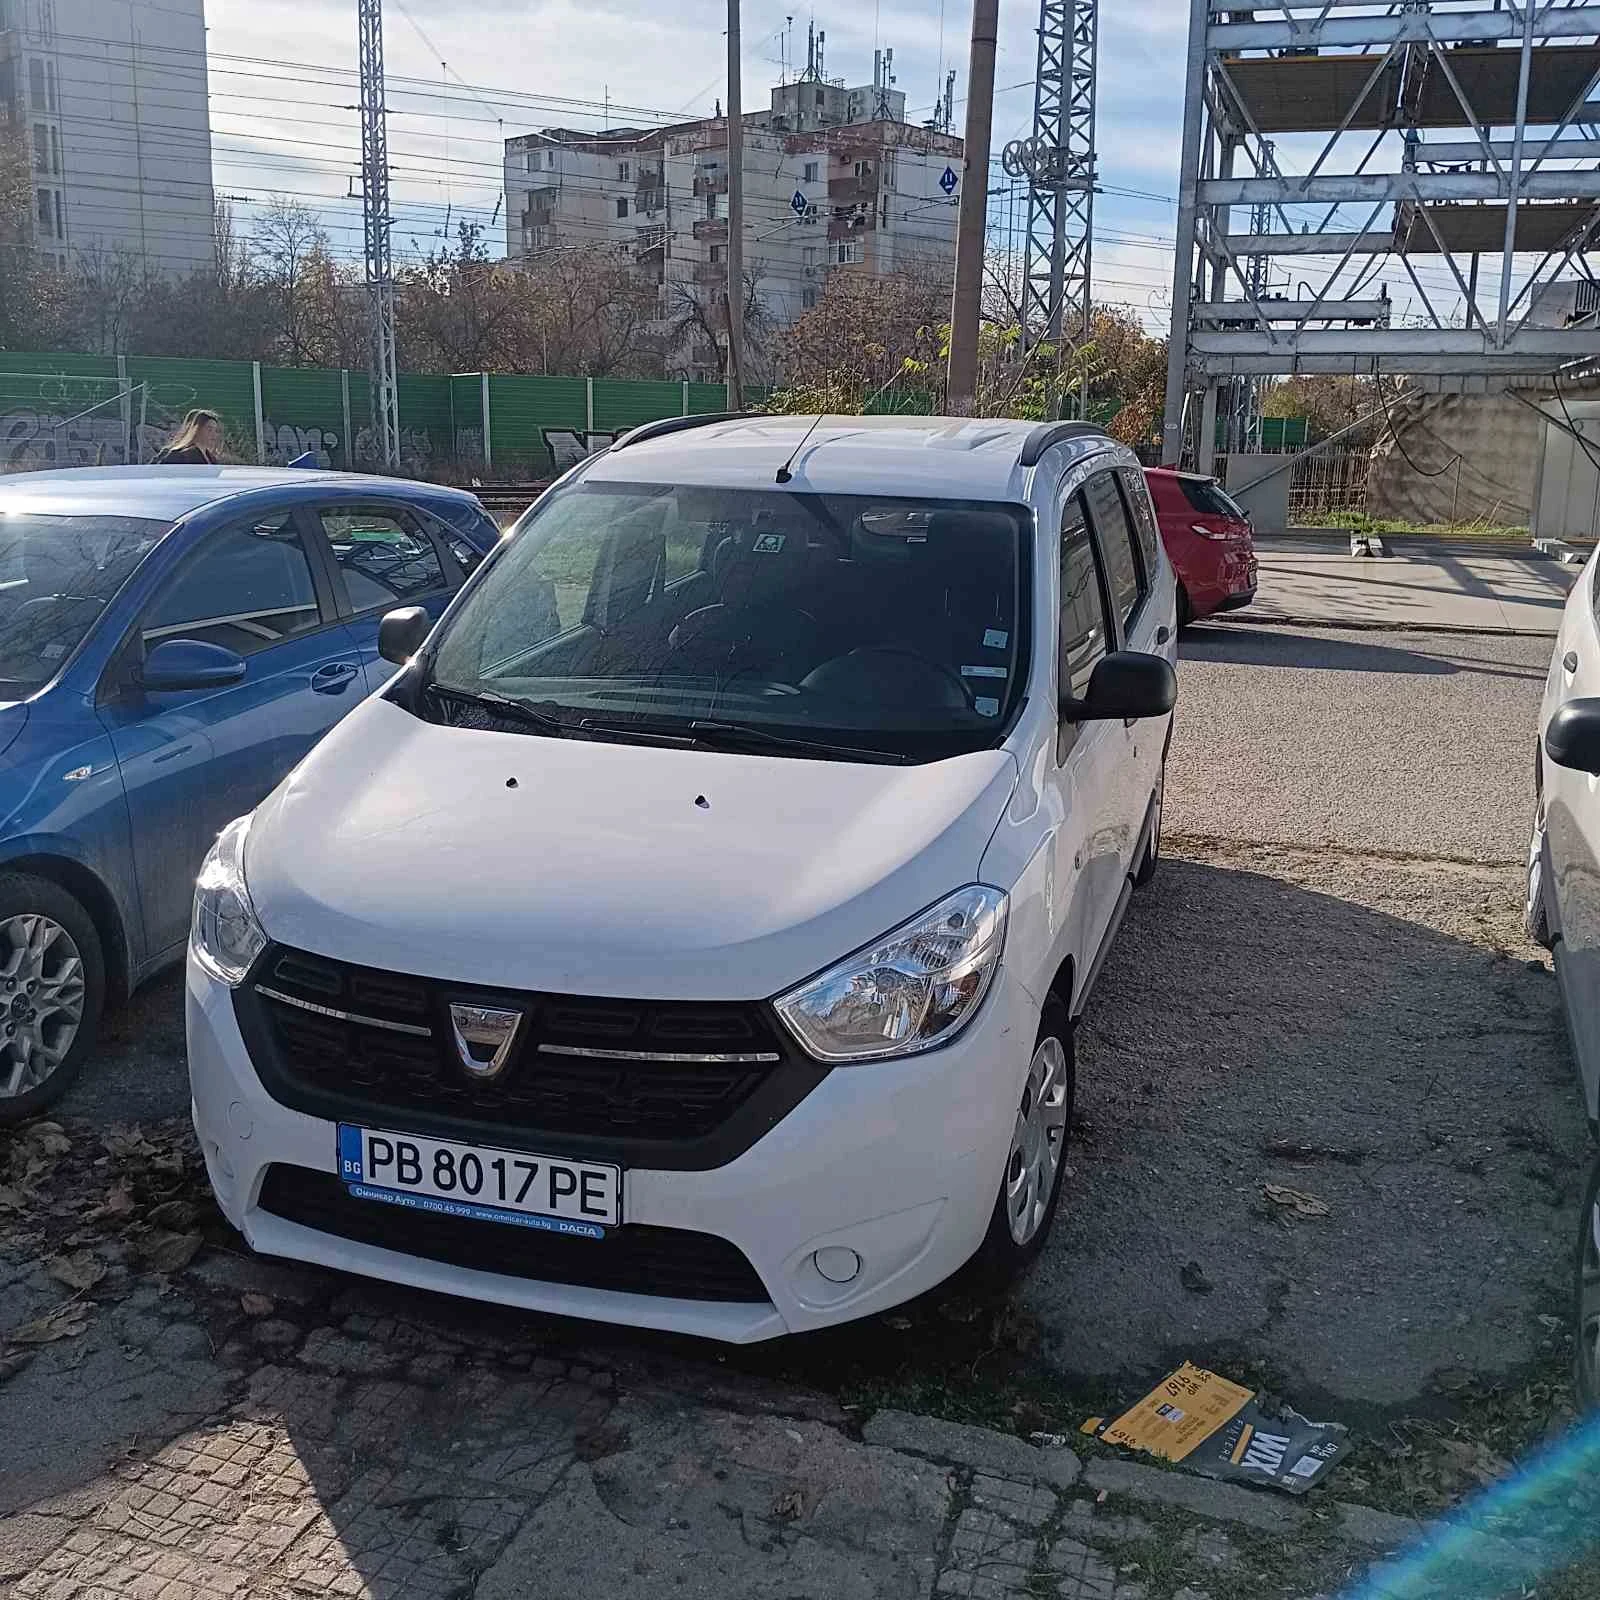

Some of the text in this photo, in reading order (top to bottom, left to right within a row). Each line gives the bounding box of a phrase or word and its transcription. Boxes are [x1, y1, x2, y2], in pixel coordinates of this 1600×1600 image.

[344, 1159, 361, 1175] BG
[368, 1136, 608, 1217] PB 8017 PE
[559, 1222, 597, 1237] DACIA
[1165, 1375, 1191, 1397] 9167
[1240, 1431, 1291, 1476] WIX
